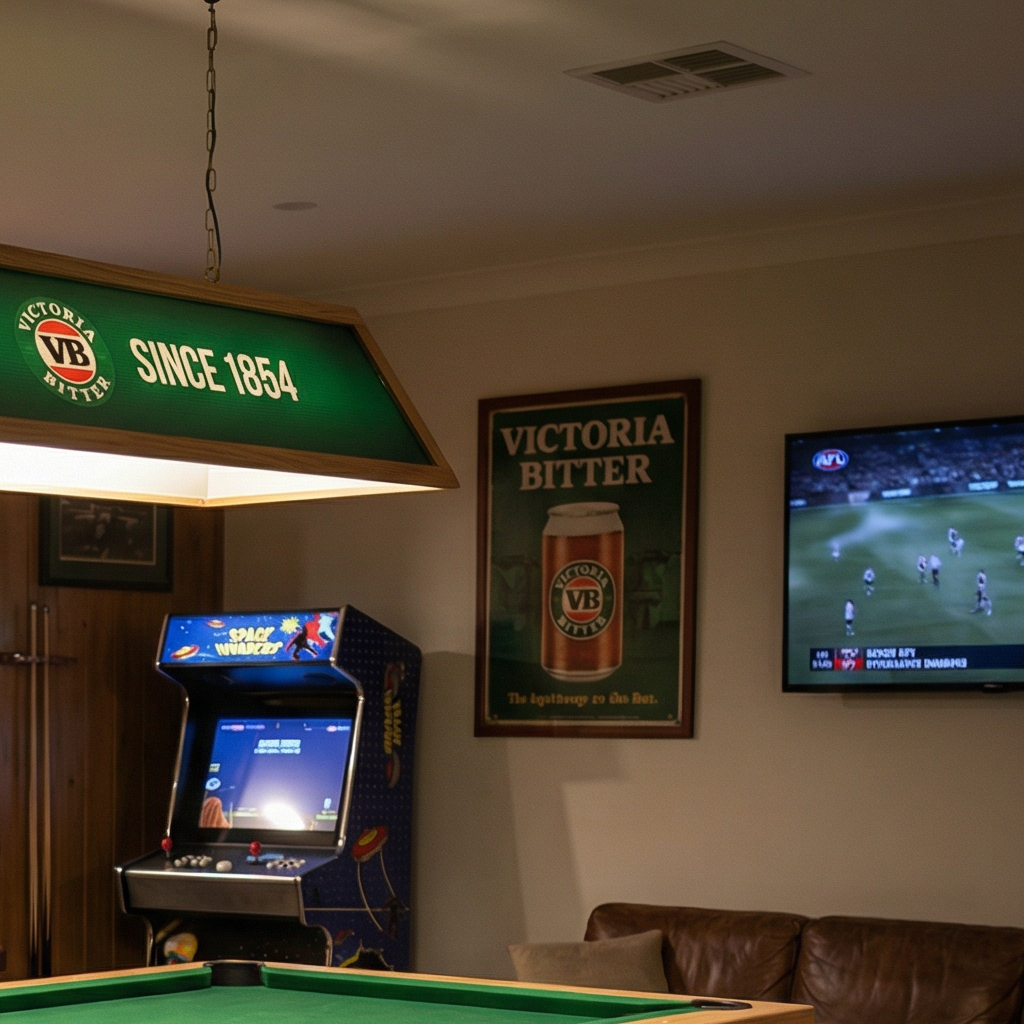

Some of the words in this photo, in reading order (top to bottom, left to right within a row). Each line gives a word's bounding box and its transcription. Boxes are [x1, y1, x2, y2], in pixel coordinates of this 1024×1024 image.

[18, 301, 96, 343] VICTORIA
[38, 334, 91, 367] VB
[129, 337, 226, 393] SINCE
[223, 351, 299, 402] 1854
[43, 370, 111, 403] BITTER
[499, 413, 676, 457] VICTORIA
[518, 453, 653, 491] BITTER
[565, 589, 601, 611] VB
